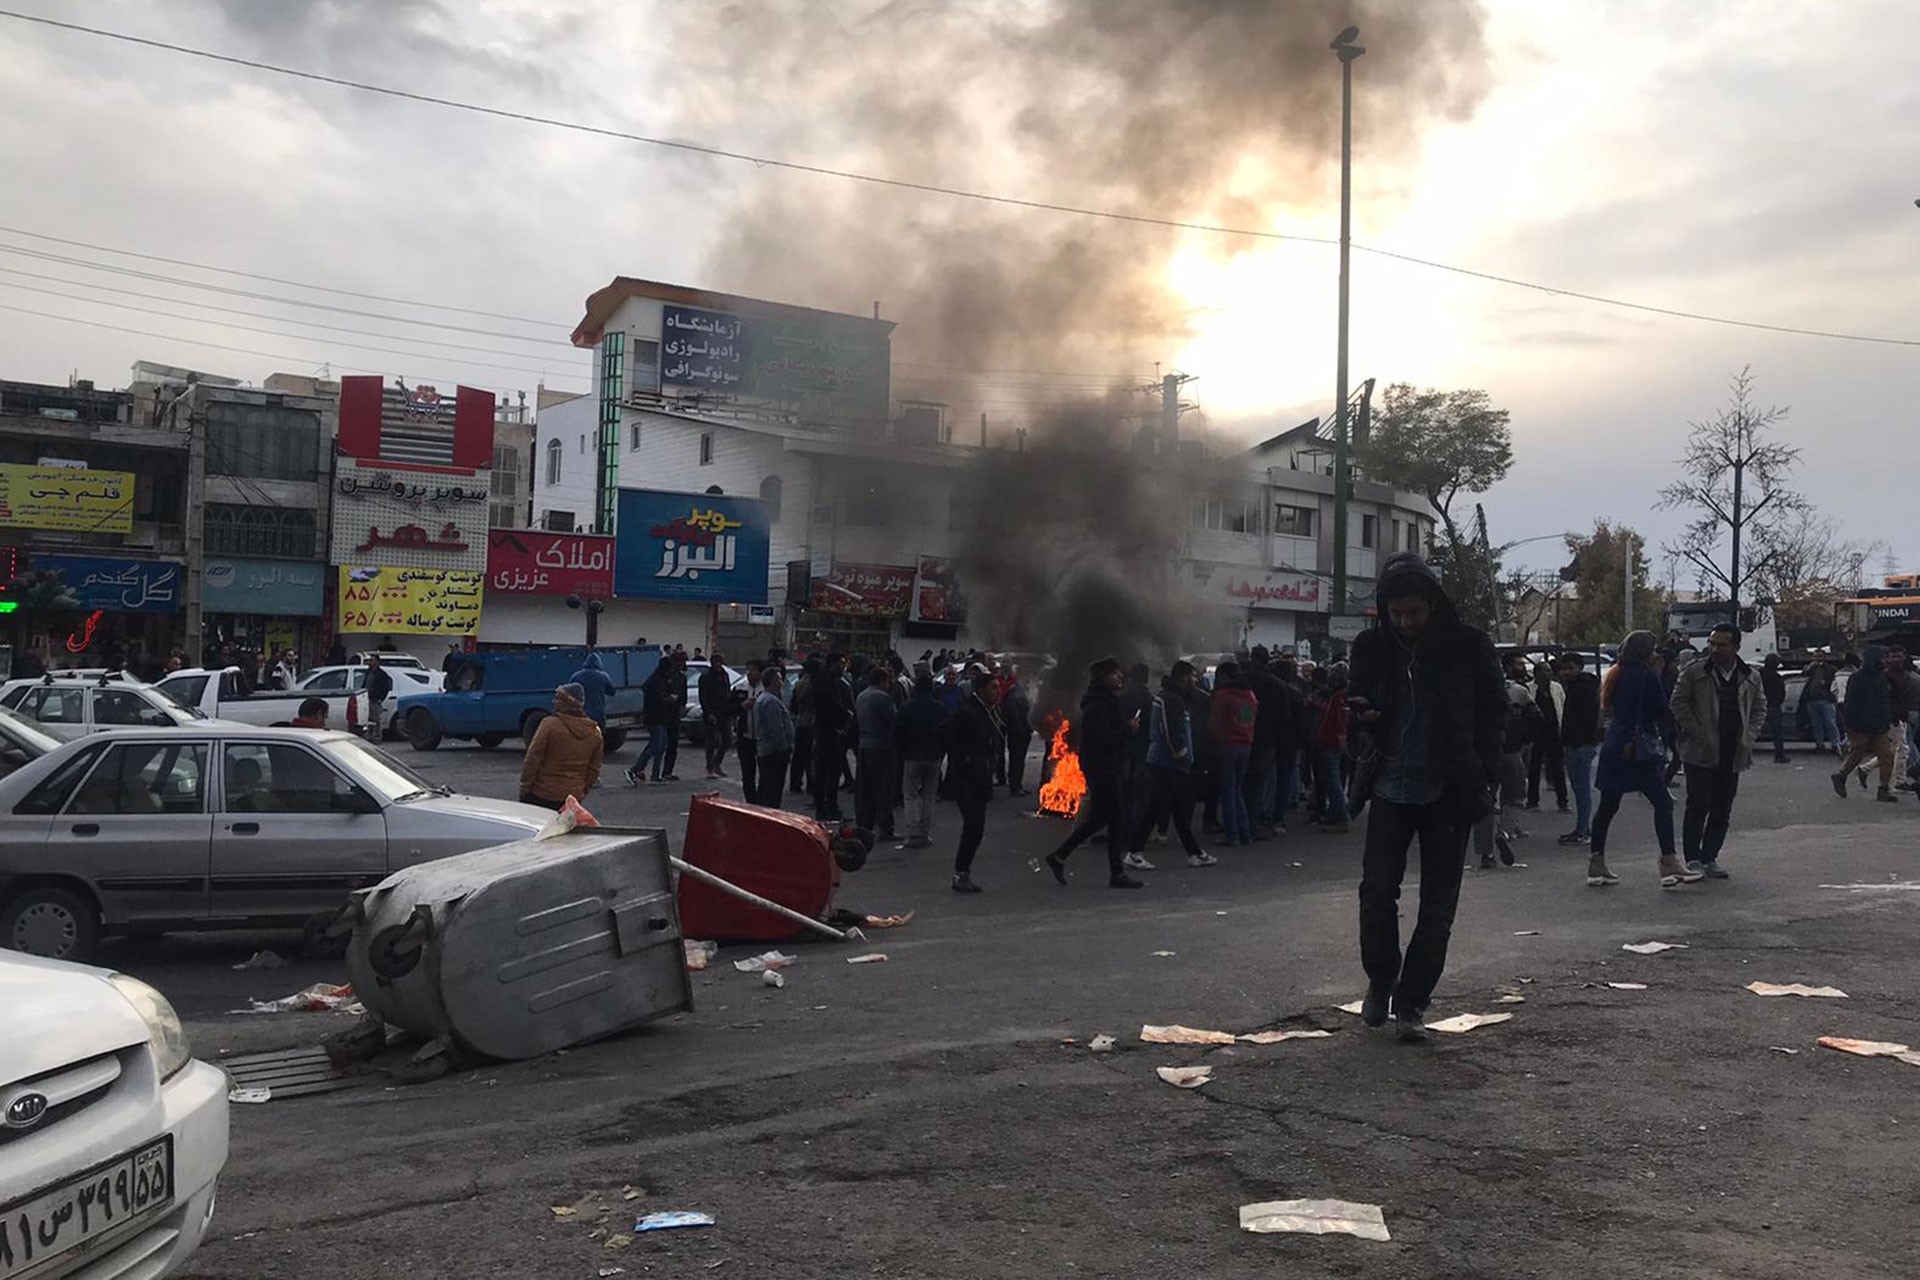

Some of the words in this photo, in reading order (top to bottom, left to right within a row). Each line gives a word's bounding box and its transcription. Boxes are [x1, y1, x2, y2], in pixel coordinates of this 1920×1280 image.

[666, 314, 741, 340] آزمایشگاه
[665, 337, 740, 363] رادیولوژی
[664, 360, 739, 384] سونوگرافی
[30, 487, 70, 500] چی
[76, 487, 121, 503] قلم
[432, 486, 487, 511] سوپر
[686, 507, 742, 533] سوپر
[356, 522, 469, 553] شهر
[536, 540, 611, 570] املاک
[655, 535, 736, 580] البرز
[81, 563, 141, 588] گندم
[121, 567, 176, 608] گل
[397, 570, 448, 584] گوسفندی
[494, 568, 549, 591] عزیزی
[407, 613, 444, 631] گوساله
